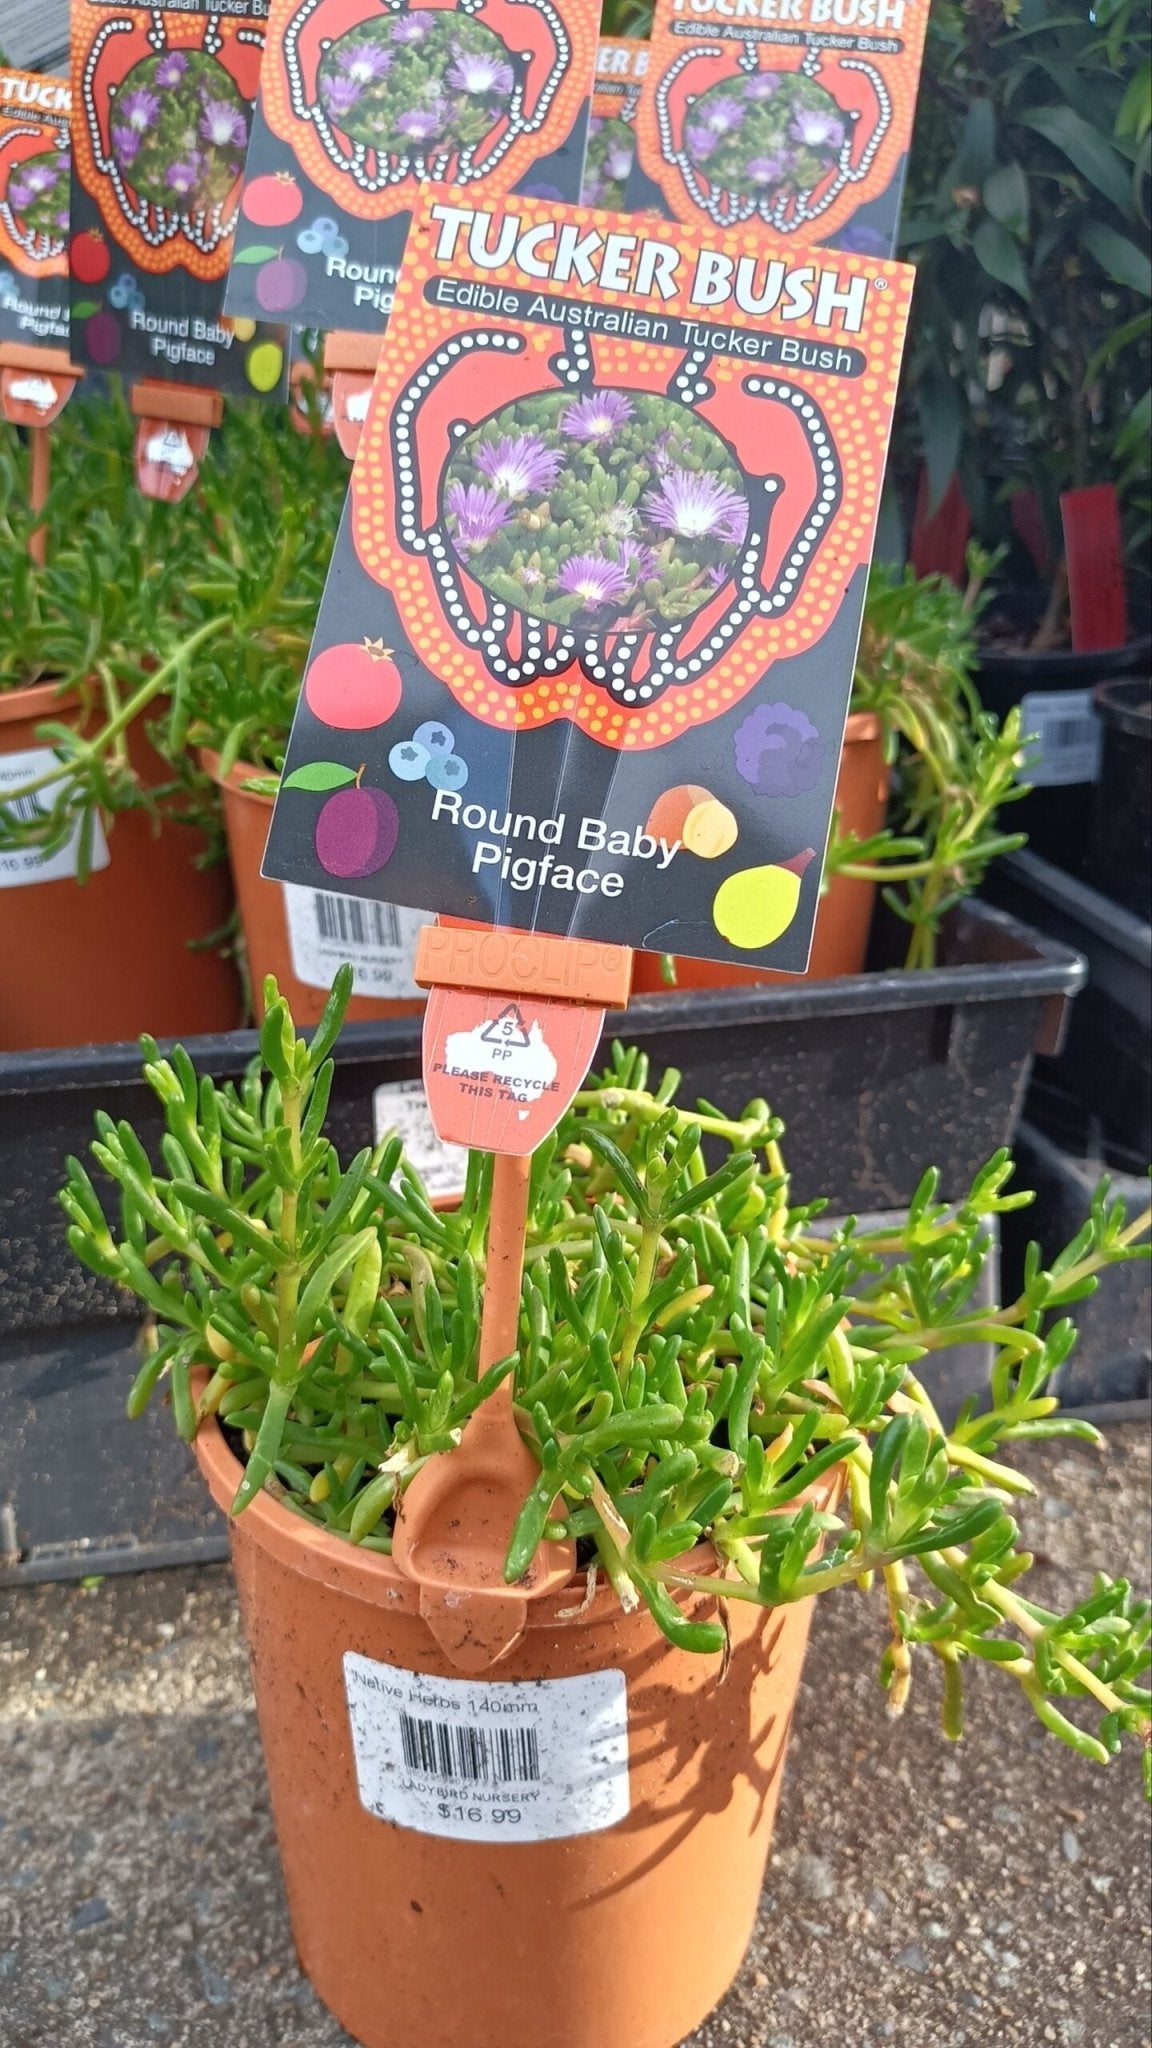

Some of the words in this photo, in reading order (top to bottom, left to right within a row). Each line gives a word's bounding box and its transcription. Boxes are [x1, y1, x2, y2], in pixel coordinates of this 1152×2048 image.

[252, 0, 272, 16] Bu
[808, 0, 904, 30] BUSH
[673, 20, 721, 38] Edible
[723, 25, 800, 45] Australian
[805, 32, 856, 50] Tucker
[857, 38, 900, 53] Bush
[0, 77, 73, 112] TUCK
[430, 203, 681, 301] TUCKER
[325, 255, 402, 285] Roun
[130, 311, 189, 338] Round
[192, 319, 235, 350] Baby
[436, 280, 519, 314] Edible
[527, 295, 669, 341] Australian
[679, 320, 773, 358] Tucker
[779, 337, 853, 373] Bush
[150, 336, 216, 366] Pigface
[430, 788, 566, 846] Round
[577, 816, 683, 871] Baby
[471, 840, 625, 898] Pigface
[501, 1020, 514, 1036] 5
[491, 1047, 513, 1061] PP
[432, 1062, 489, 1083] PLEASE
[493, 1073, 561, 1092] RECYCLE
[459, 1082, 493, 1098] THIS
[498, 1089, 528, 1103] TAG
[409, 1689, 461, 1711] Herbs
[468, 1698, 539, 1714] 140mm
[402, 1778, 470, 1801] LADYBIRD
[472, 1789, 541, 1803] NURSERY
[437, 1802, 522, 1824] $16.99
